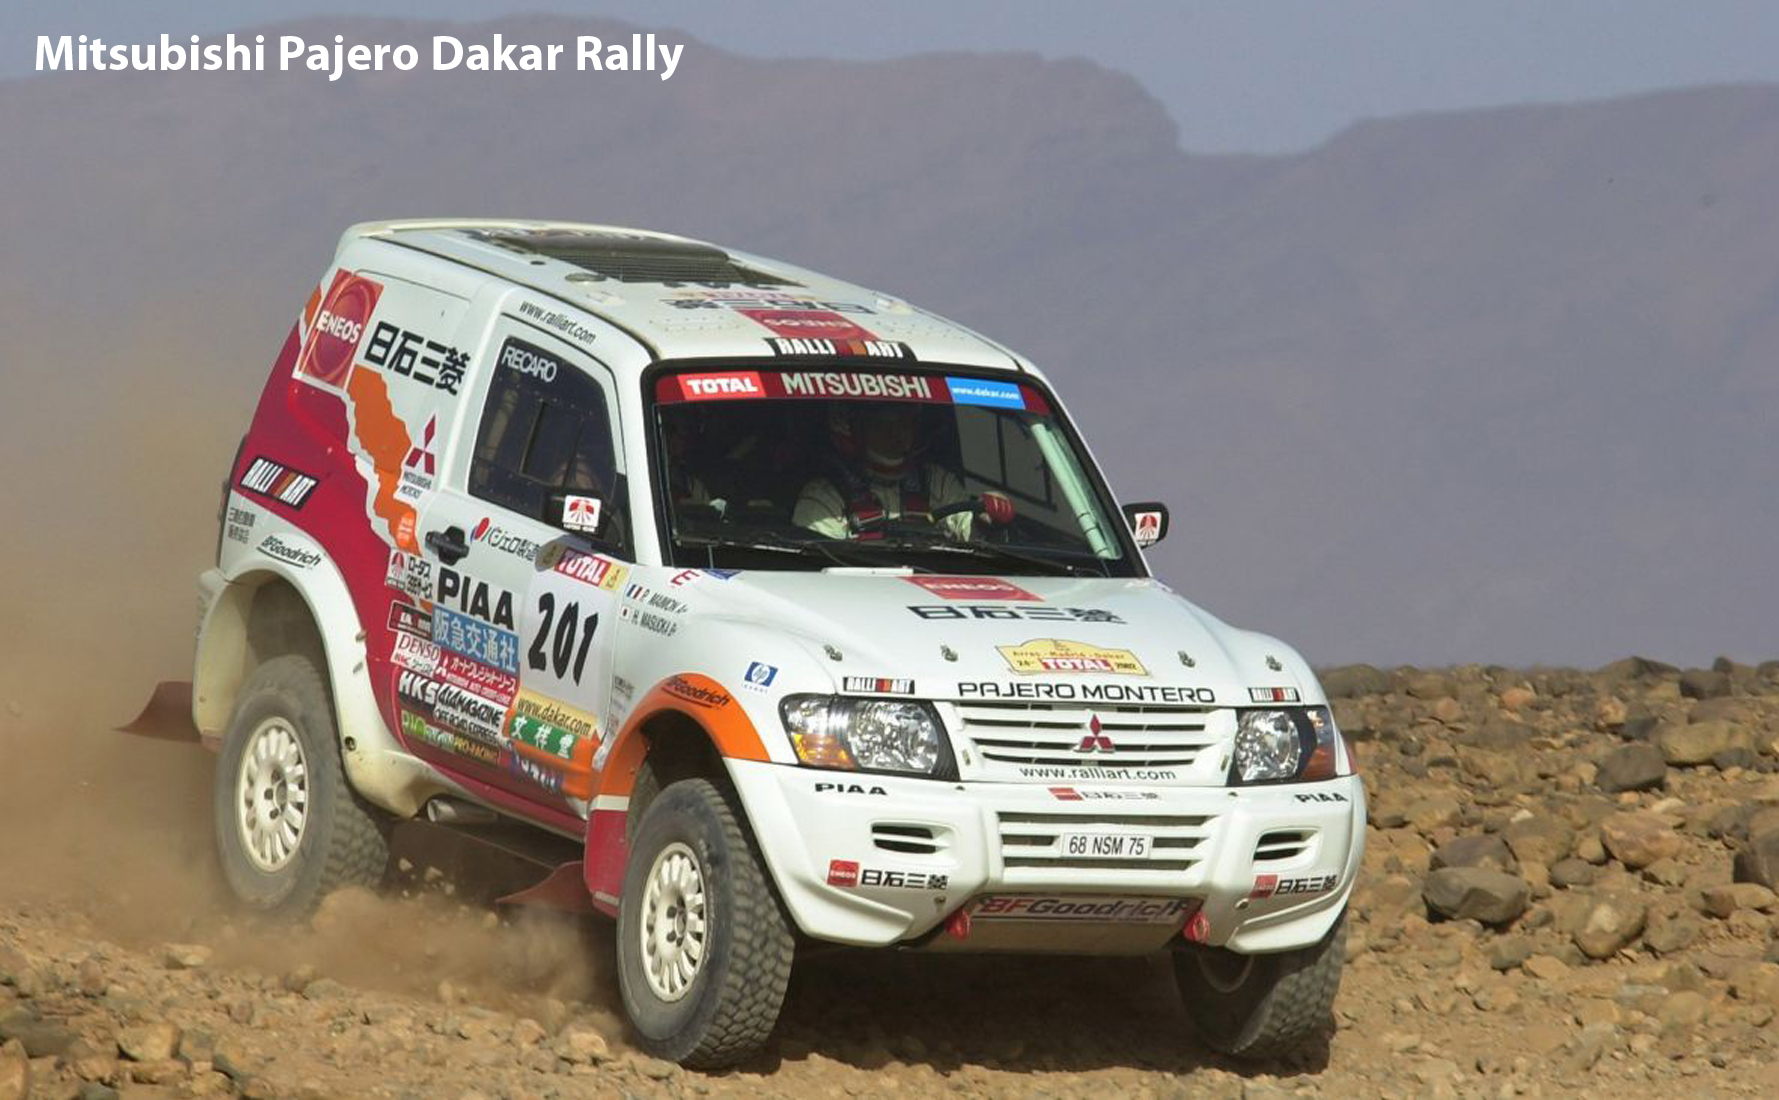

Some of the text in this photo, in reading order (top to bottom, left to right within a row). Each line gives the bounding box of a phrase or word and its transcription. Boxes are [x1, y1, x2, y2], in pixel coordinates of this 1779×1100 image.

[316, 310, 362, 344] ENEOS
[519, 301, 597, 345] www.ralliart.com
[363, 320, 471, 396] 日石三菱
[775, 338, 903, 358] RALLI ART
[501, 347, 558, 383] RECARO
[687, 377, 759, 394] TOTAL
[780, 372, 932, 398] MITSUBISHI
[240, 458, 317, 506] RALLI ART
[261, 535, 321, 566] BFGoodrich
[557, 551, 606, 585] TOTAL
[438, 567, 513, 630] PIAA
[907, 606, 1127, 624] 日石三菱
[399, 633, 440, 661] DENSO
[434, 609, 516, 672] 阪急交通社
[528, 592, 598, 686] 201
[1042, 659, 1111, 670] TOTAL
[399, 671, 440, 705] HKS
[958, 682, 1215, 702] PAJERO MONTERO
[518, 699, 591, 736] www.dakar.com
[1019, 767, 1177, 781] www.ralliart.com
[815, 783, 888, 796] PIAA
[1294, 793, 1349, 802] PIAA
[1069, 836, 1144, 855] 68 NSM 75
[861, 869, 949, 890] 日石三菱
[980, 897, 1184, 917] BFGoodrich
